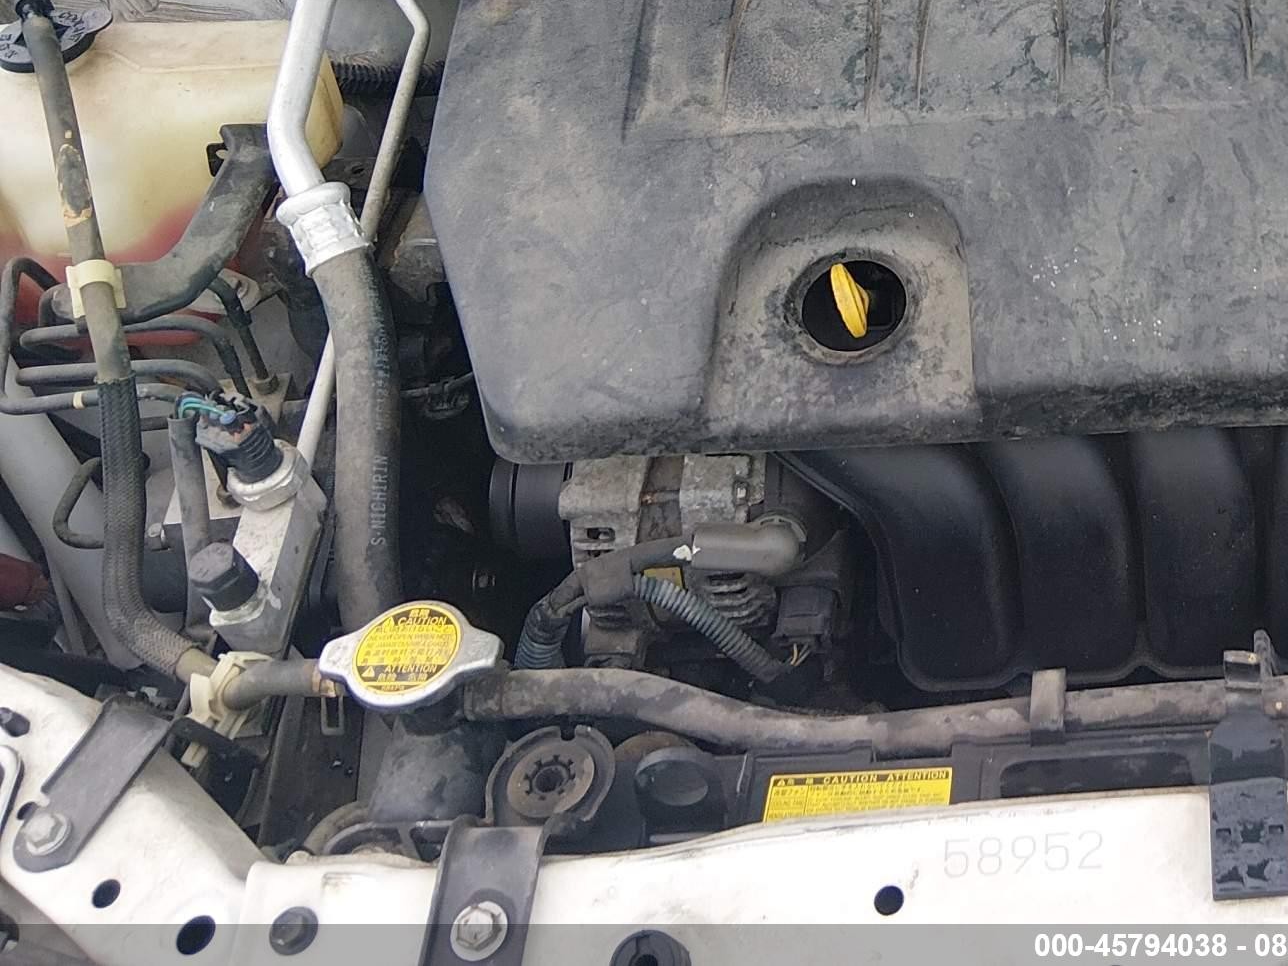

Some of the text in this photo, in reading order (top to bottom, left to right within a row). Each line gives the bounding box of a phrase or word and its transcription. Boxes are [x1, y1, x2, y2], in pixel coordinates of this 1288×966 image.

[397, 617, 447, 626] CAUTION
[385, 665, 437, 674] ATTENTION
[823, 772, 877, 783] CAUTION
[887, 770, 947, 781] ATTENTION
[943, 830, 1104, 879] 58952
